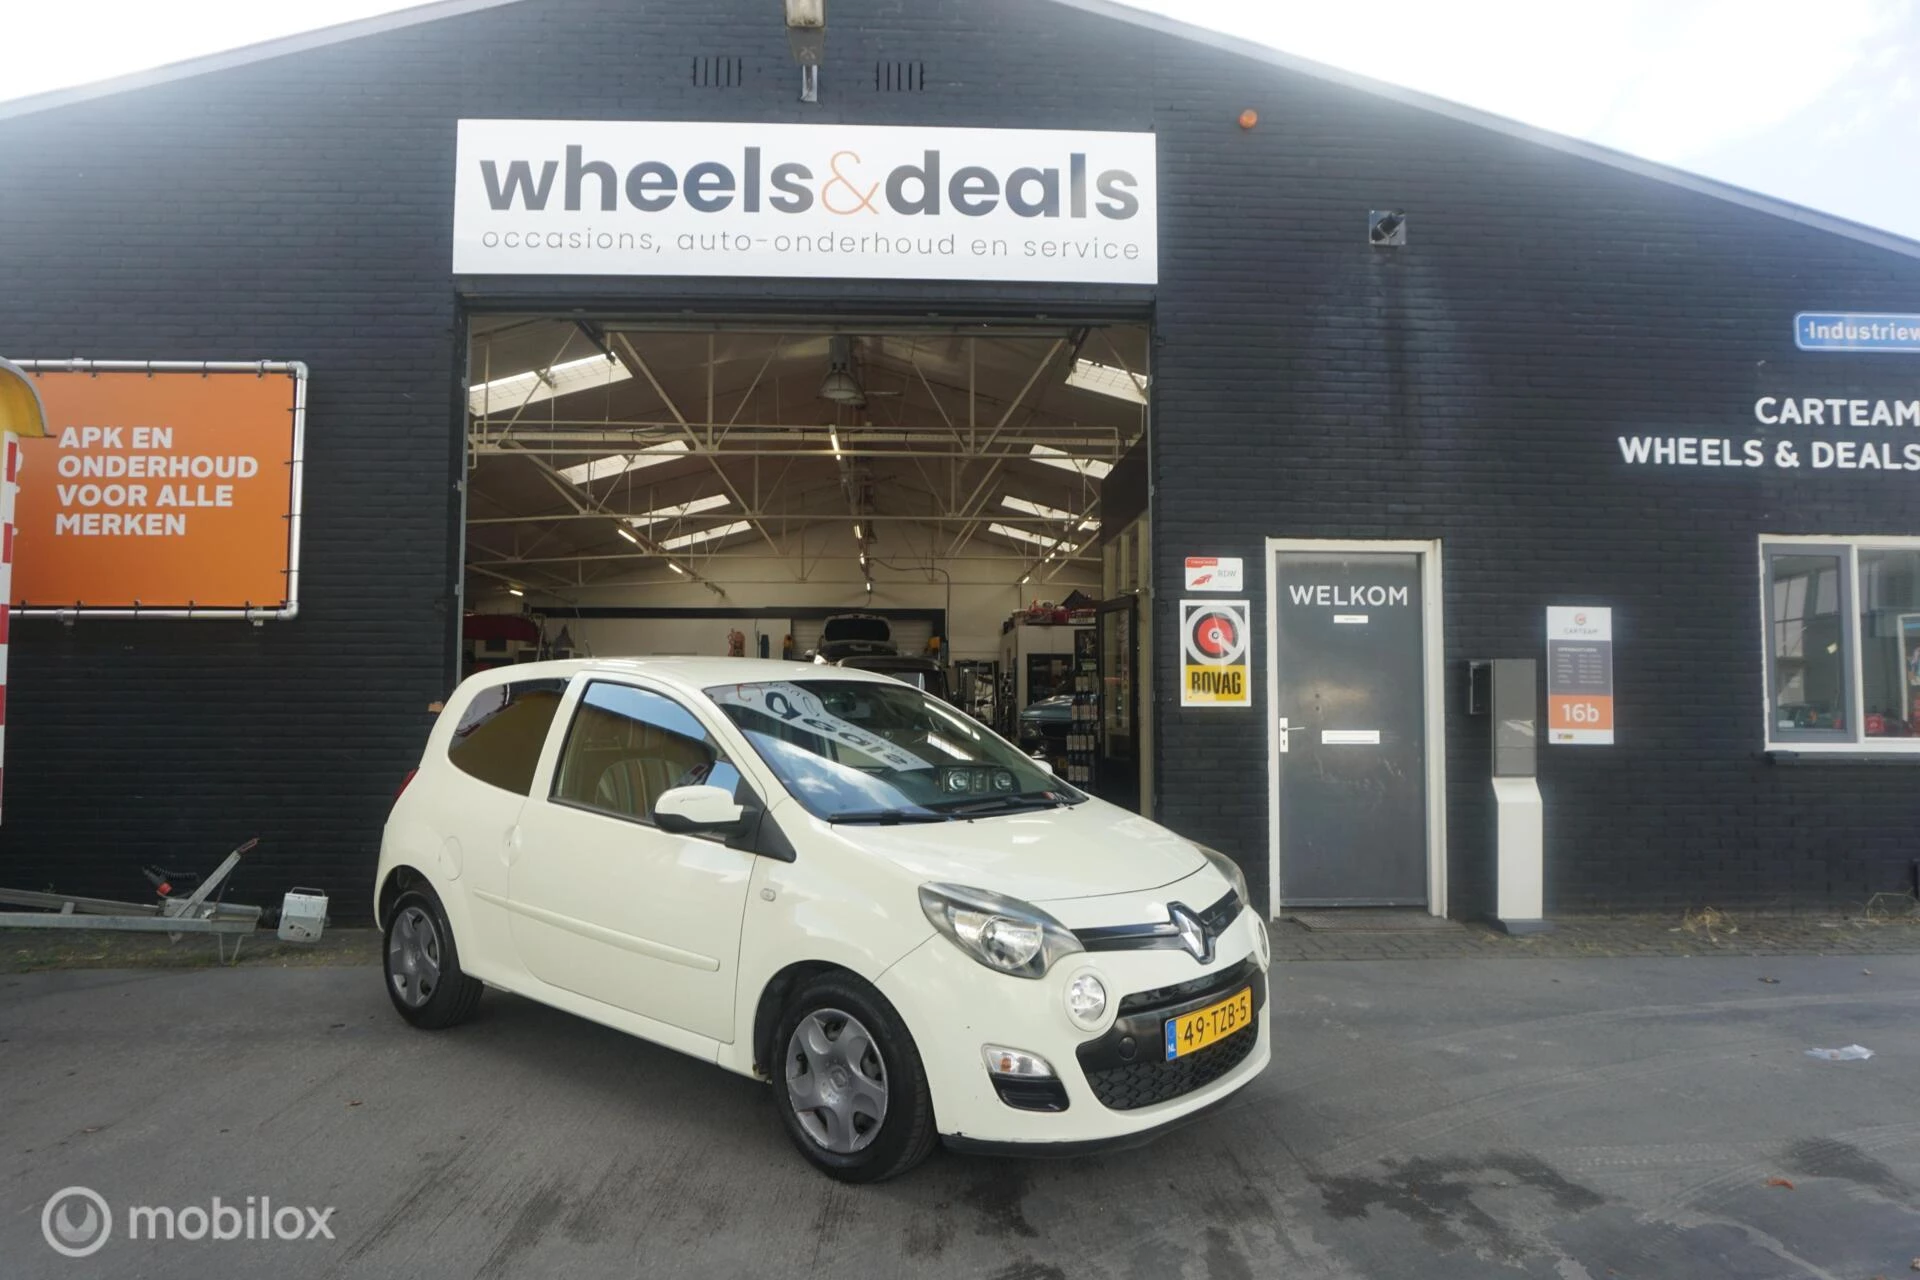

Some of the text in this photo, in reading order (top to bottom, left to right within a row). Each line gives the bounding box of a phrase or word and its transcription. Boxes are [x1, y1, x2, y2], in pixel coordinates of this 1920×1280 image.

[479, 145, 1139, 220] wheels&deals
[482, 229, 1140, 261] occasions, auto-onderhoud en service
[1754, 397, 1920, 427] CARTEAM
[59, 427, 172, 448] APK EN
[1618, 436, 1920, 471] WHEELS & DEALS
[57, 455, 258, 478] ONDERHOUD
[57, 484, 233, 507] VOOR ALLE
[55, 513, 186, 536] MERKEN
[1289, 585, 1408, 606] WELKOM
[1191, 671, 1241, 695] BOVAG
[1562, 702, 1600, 723] 16b
[1184, 996, 1247, 1046] 49-TZB-5
